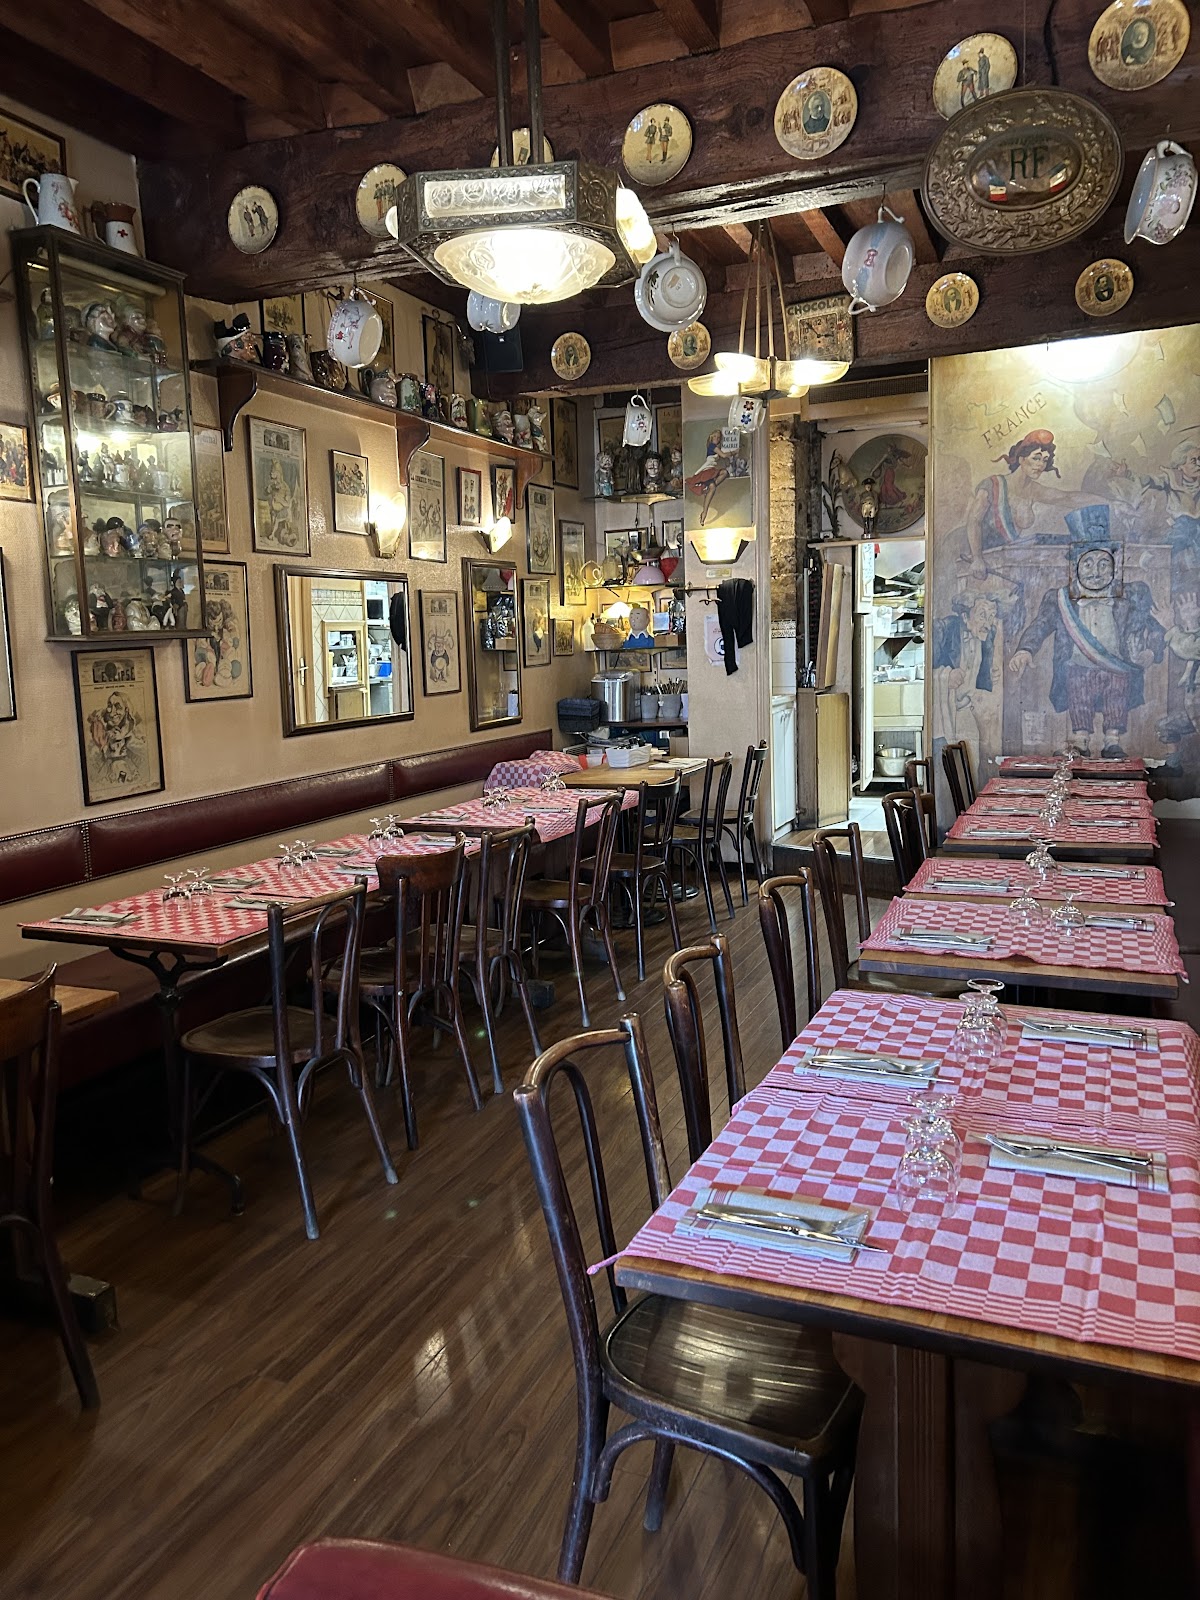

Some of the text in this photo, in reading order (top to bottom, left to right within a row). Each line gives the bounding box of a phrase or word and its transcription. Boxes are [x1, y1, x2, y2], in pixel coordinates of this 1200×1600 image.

[1009, 145, 1049, 181] RF
[787, 296, 847, 316] CHOCOLAT
[981, 392, 1047, 449] FRANCE
